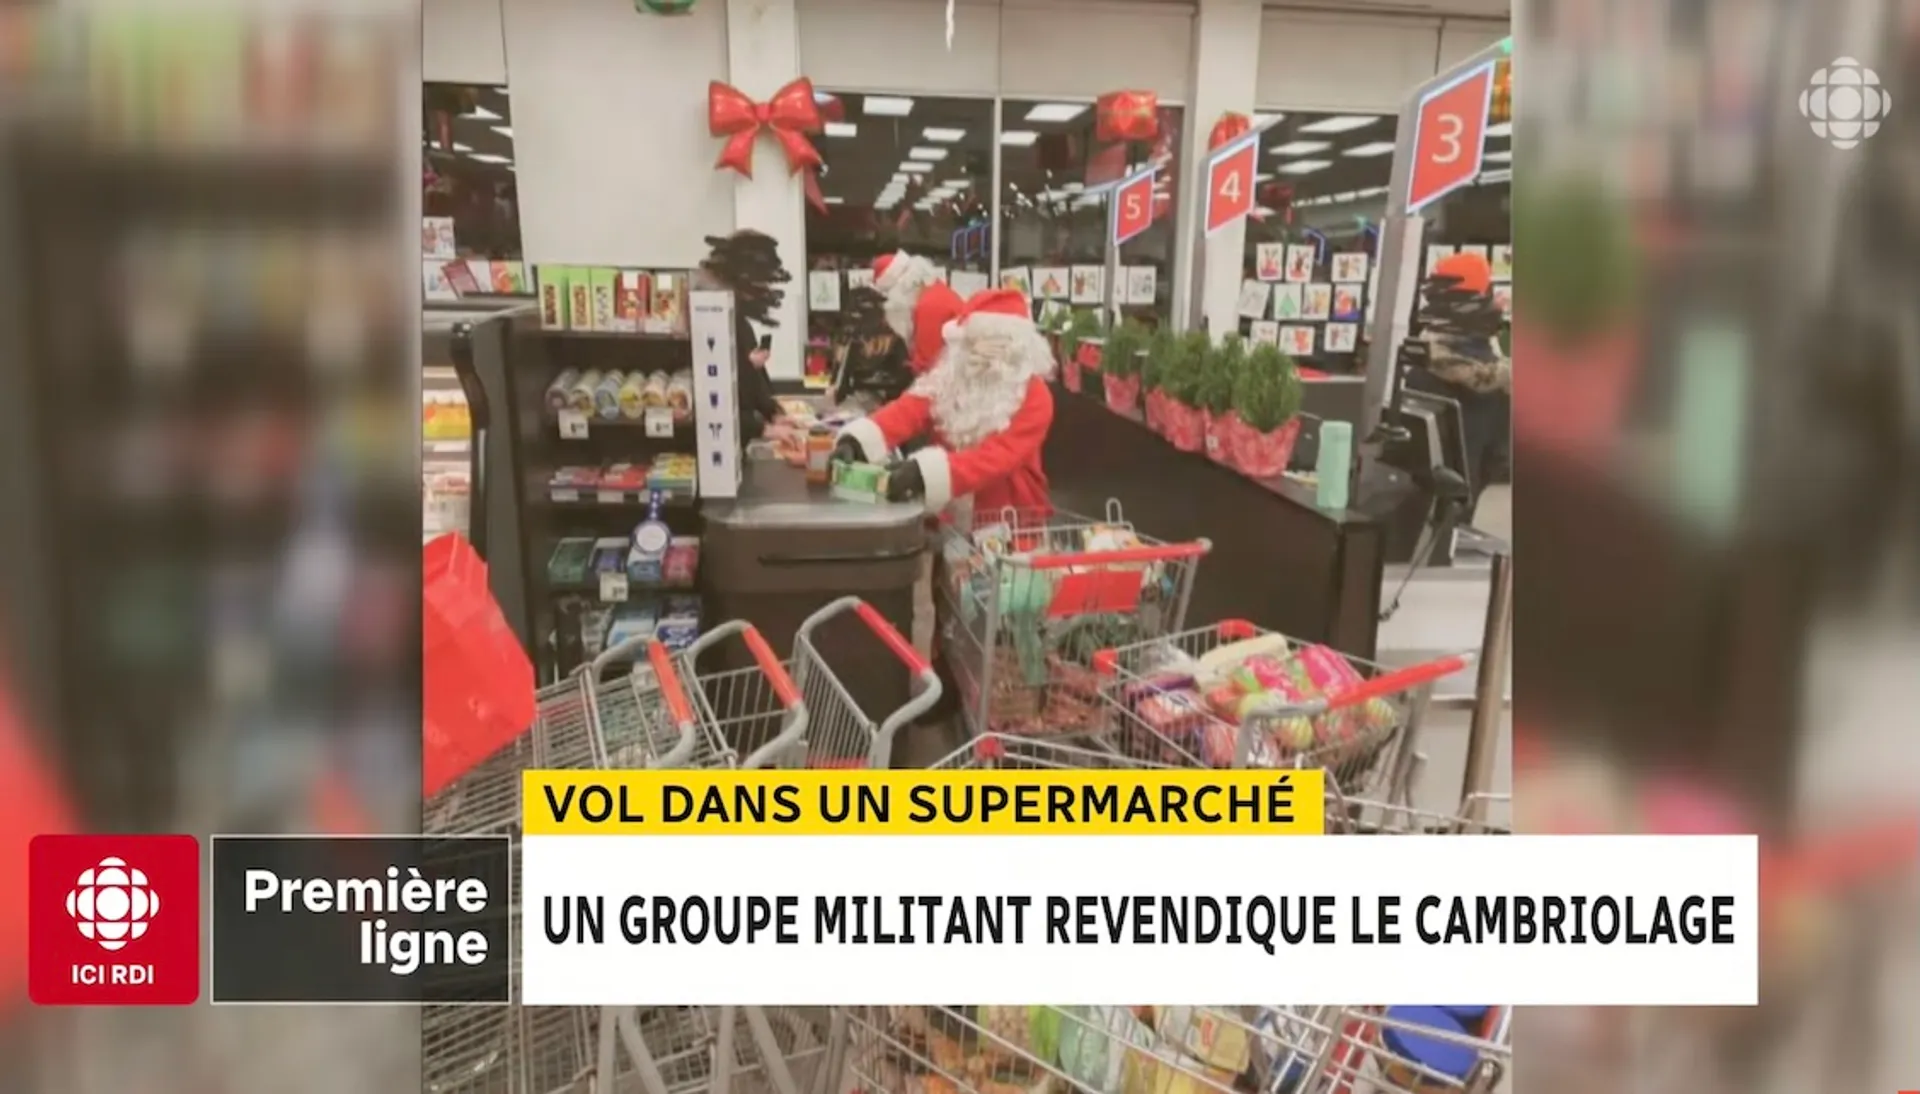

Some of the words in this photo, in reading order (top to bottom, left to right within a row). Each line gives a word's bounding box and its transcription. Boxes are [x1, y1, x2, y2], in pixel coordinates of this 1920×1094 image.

[1432, 113, 1464, 165] 3
[1219, 169, 1242, 204] 4
[1125, 194, 1142, 220] 5
